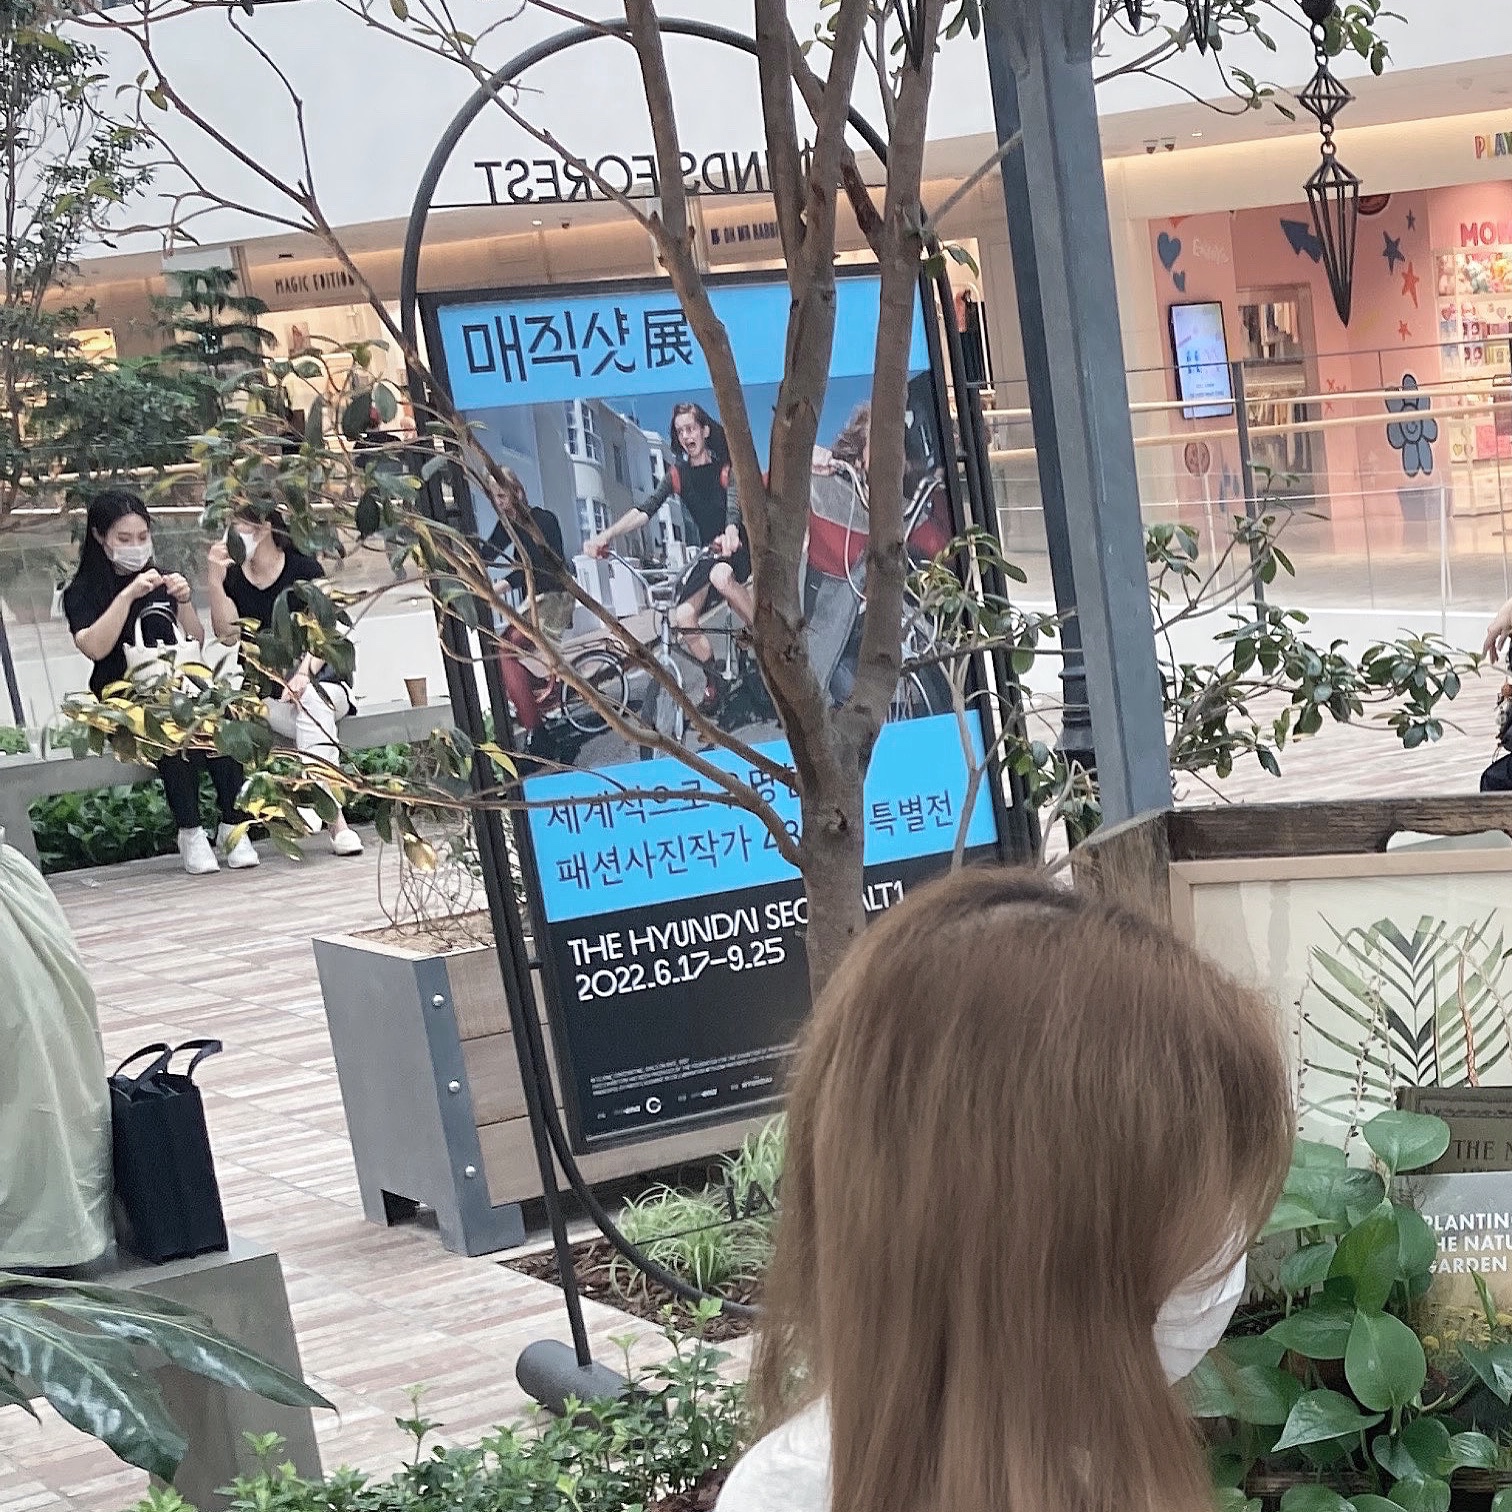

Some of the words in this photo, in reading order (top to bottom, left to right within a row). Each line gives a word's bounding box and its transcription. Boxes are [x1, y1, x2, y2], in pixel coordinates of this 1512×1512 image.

[274, 275, 309, 295] MAGIC
[461, 307, 637, 383] 매직샷
[556, 823, 753, 891] 패션사진작가
[868, 789, 956, 837] 특별전
[567, 931, 624, 967] THE
[628, 908, 760, 956] HYUNDAI
[1452, 1139, 1496, 1160] THE
[1435, 1235, 1458, 1253] HE
